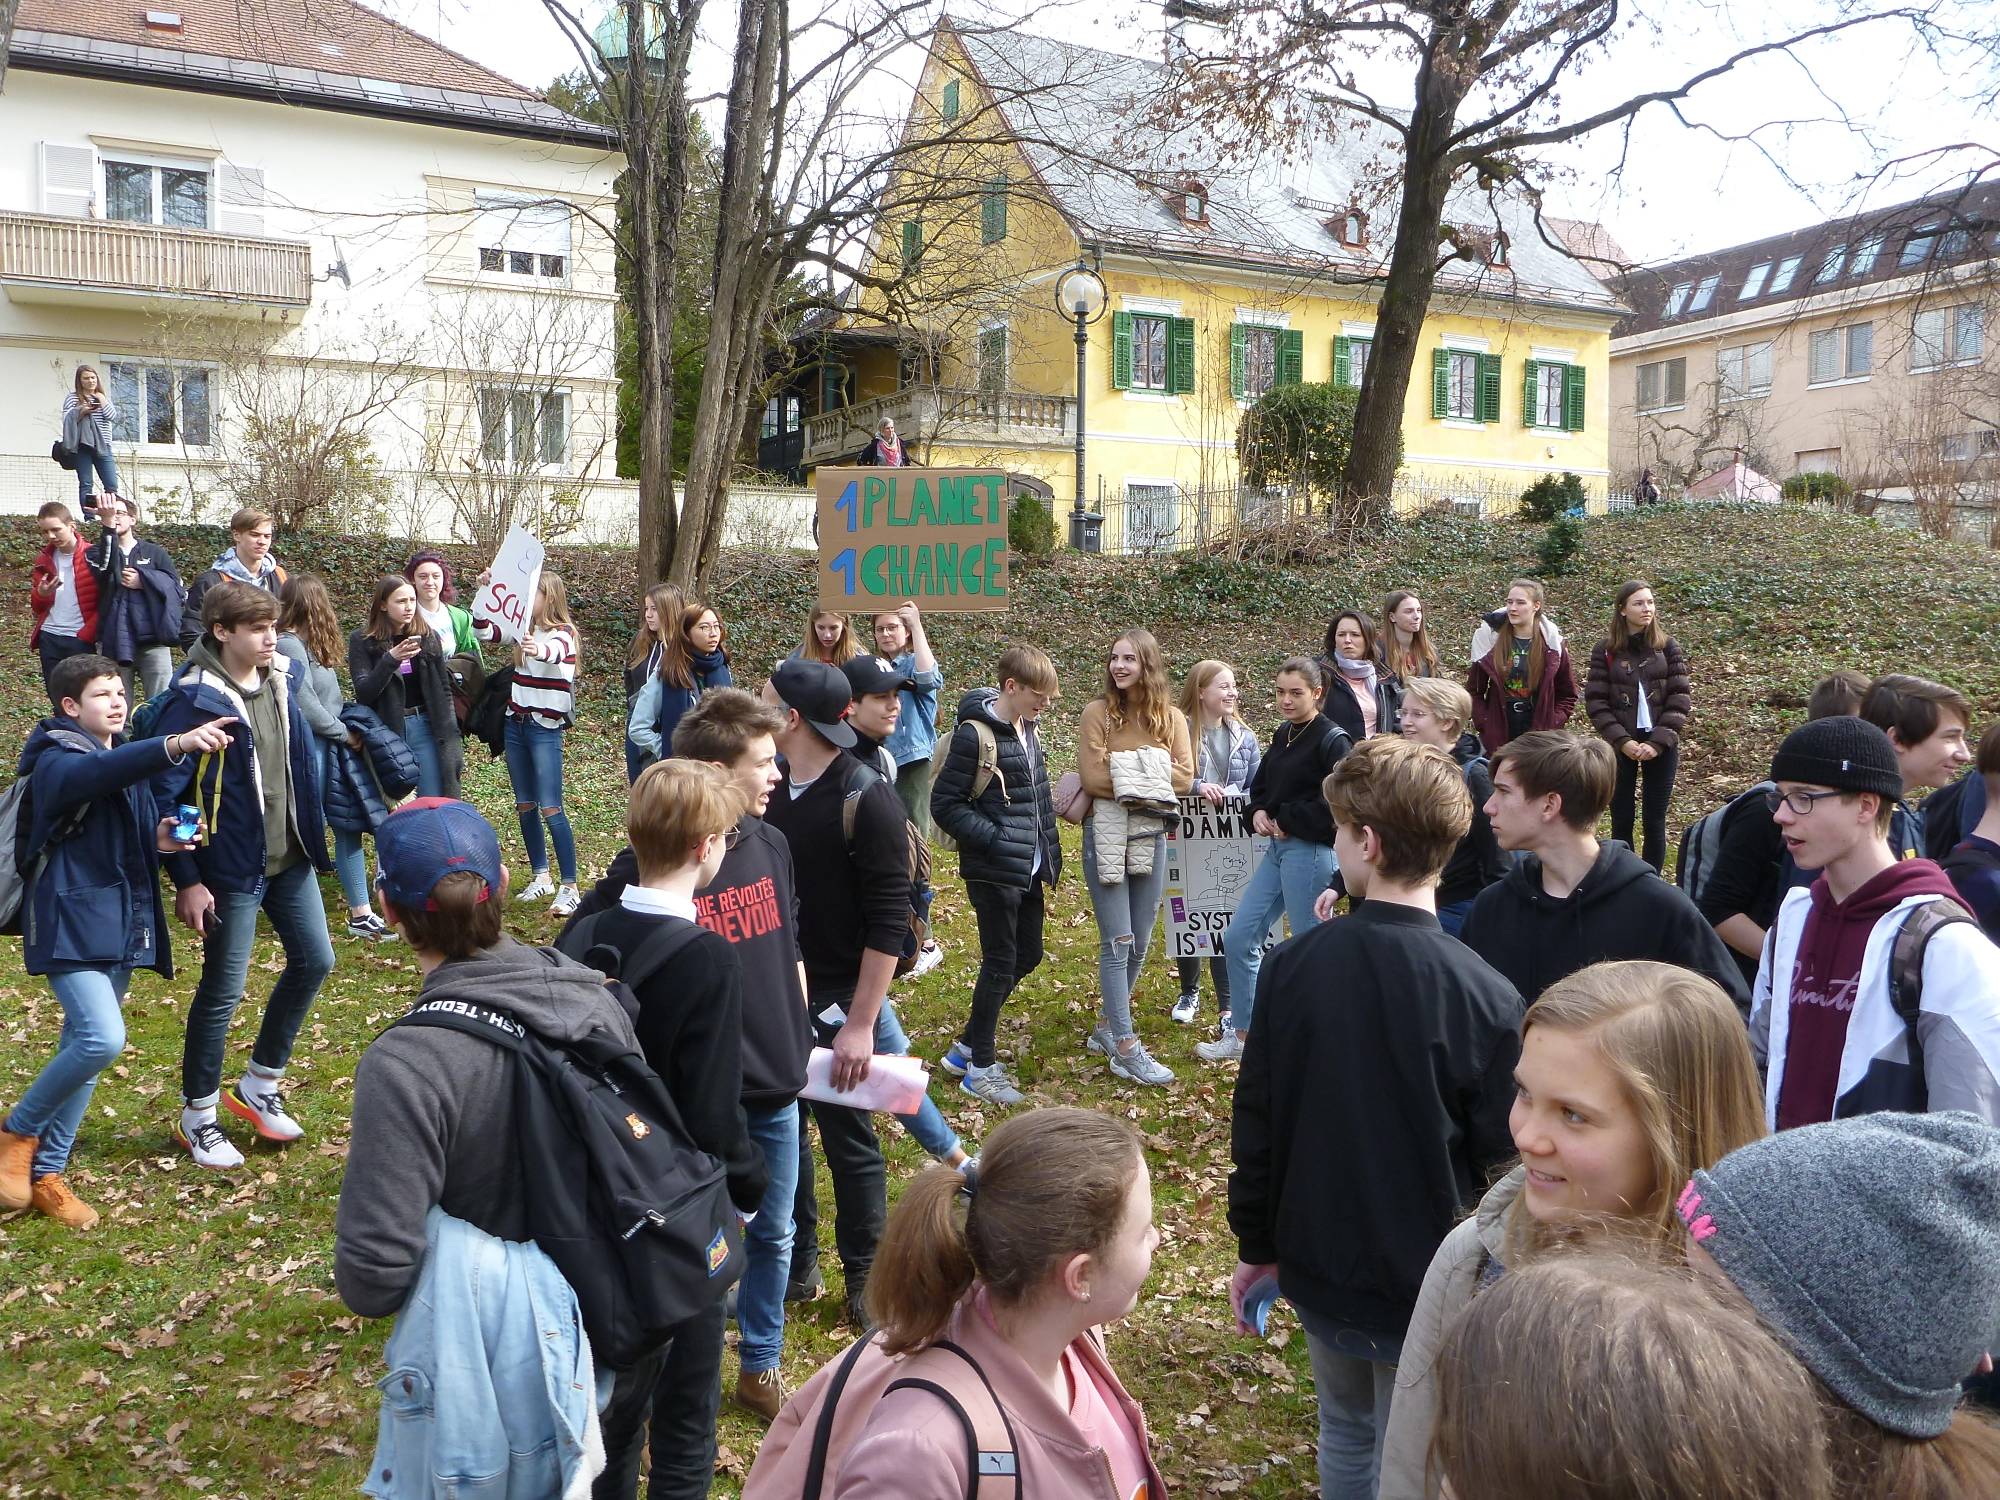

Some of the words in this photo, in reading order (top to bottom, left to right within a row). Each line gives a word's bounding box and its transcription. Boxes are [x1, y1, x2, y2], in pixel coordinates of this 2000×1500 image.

[834, 480, 858, 533] 1
[863, 475, 1006, 529] PLANET
[829, 548, 857, 596] 1
[860, 538, 1006, 597] CHANCE
[1178, 797, 1209, 816] THE
[1182, 816, 1253, 839] DAMN
[1188, 911, 1236, 931] SYST
[1176, 932, 1196, 956] IS
[416, 1000, 479, 1019] TEDDY
